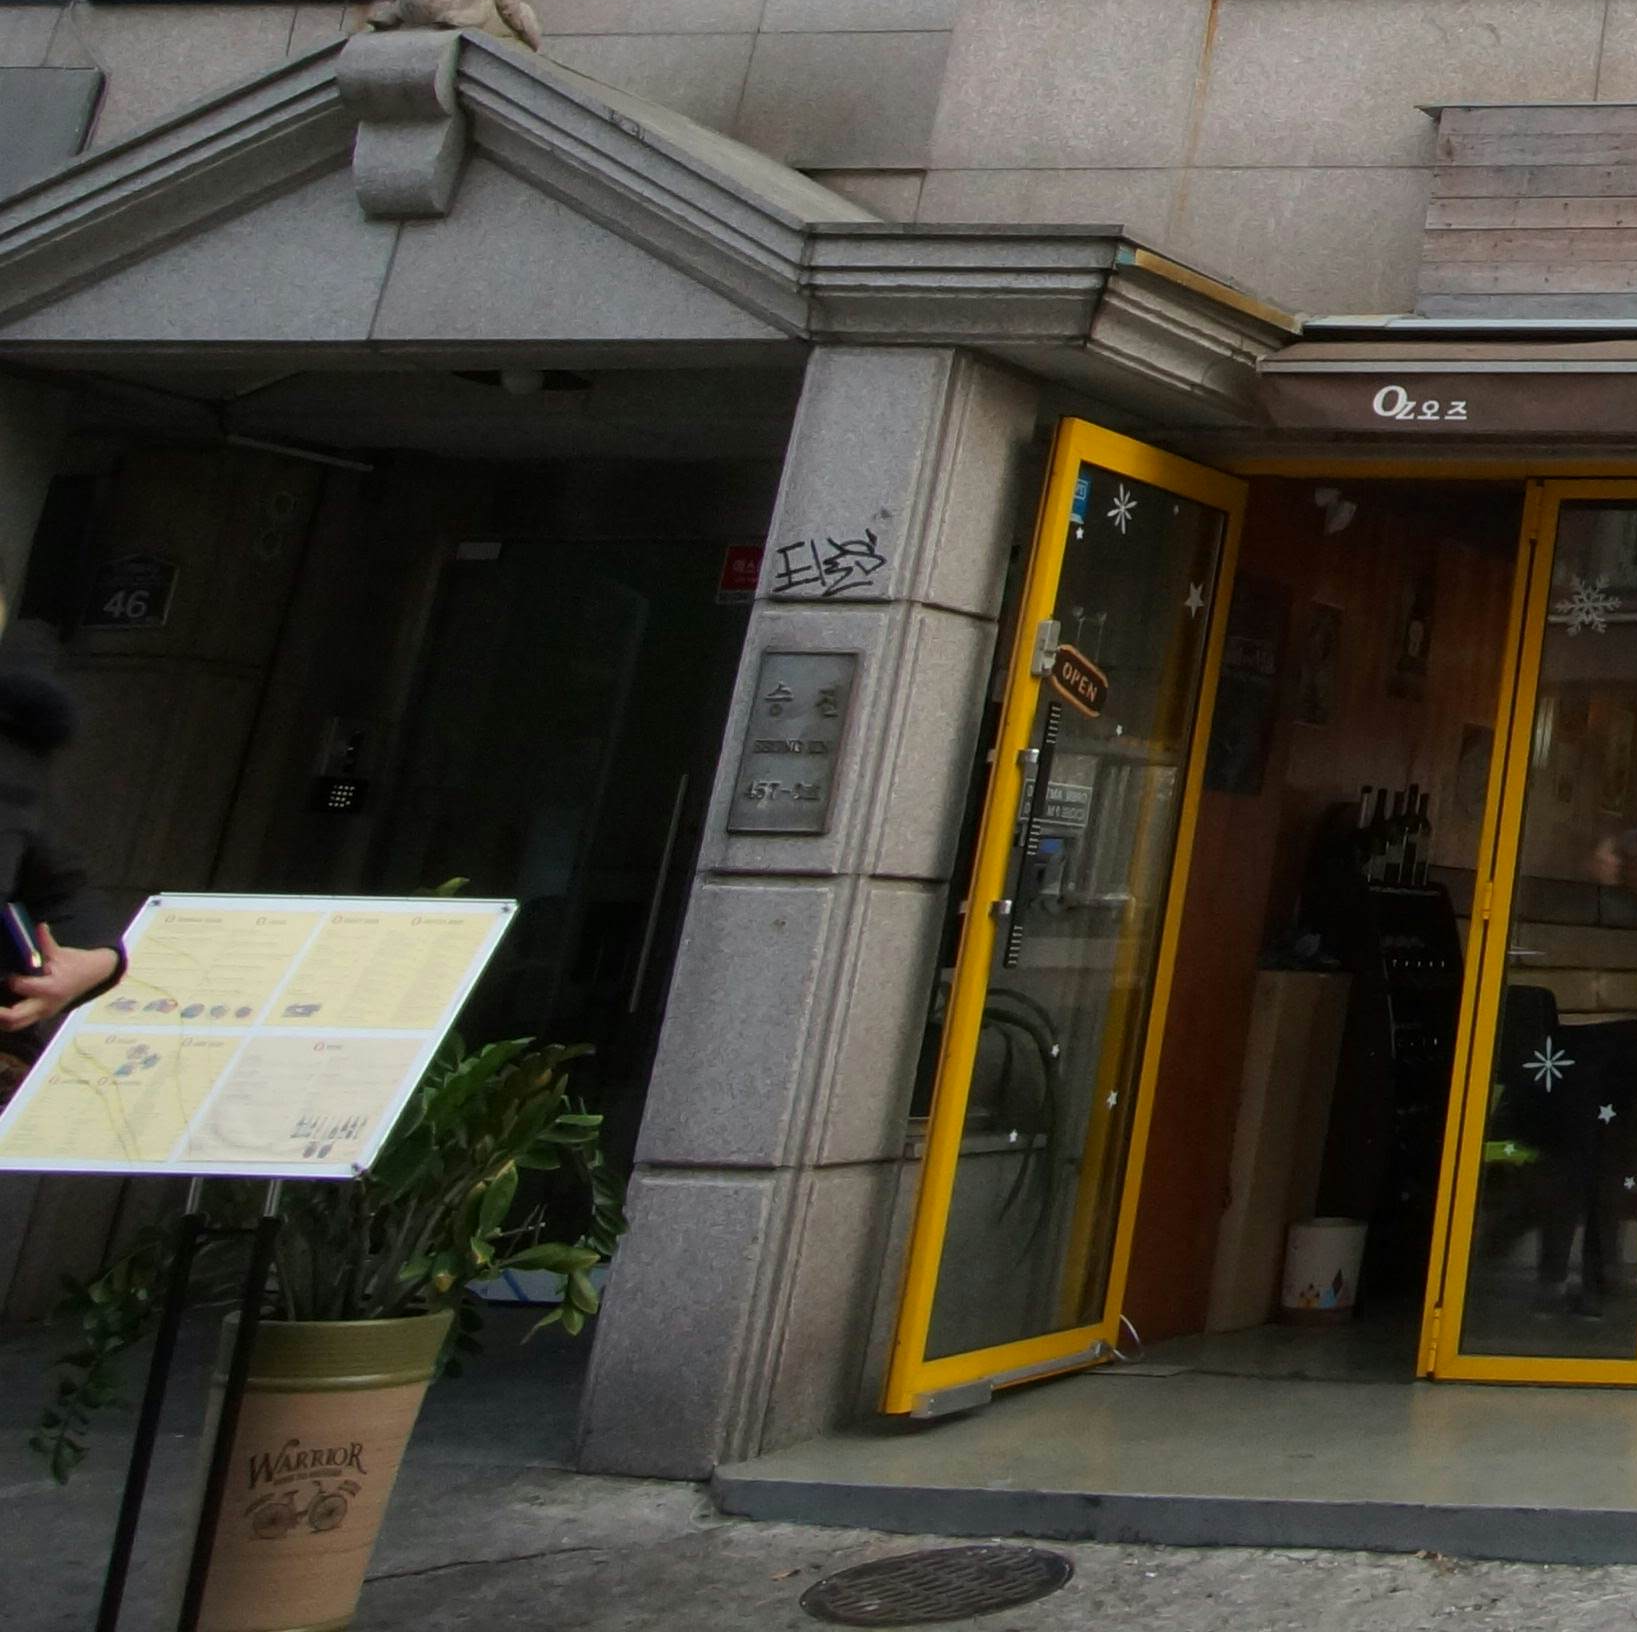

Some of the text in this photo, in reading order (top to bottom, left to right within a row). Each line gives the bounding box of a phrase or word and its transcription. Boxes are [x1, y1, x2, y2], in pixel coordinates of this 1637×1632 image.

[103, 589, 147, 618] 46
[1062, 661, 1098, 702] OPEN
[248, 1439, 367, 1489] WARRIOR
